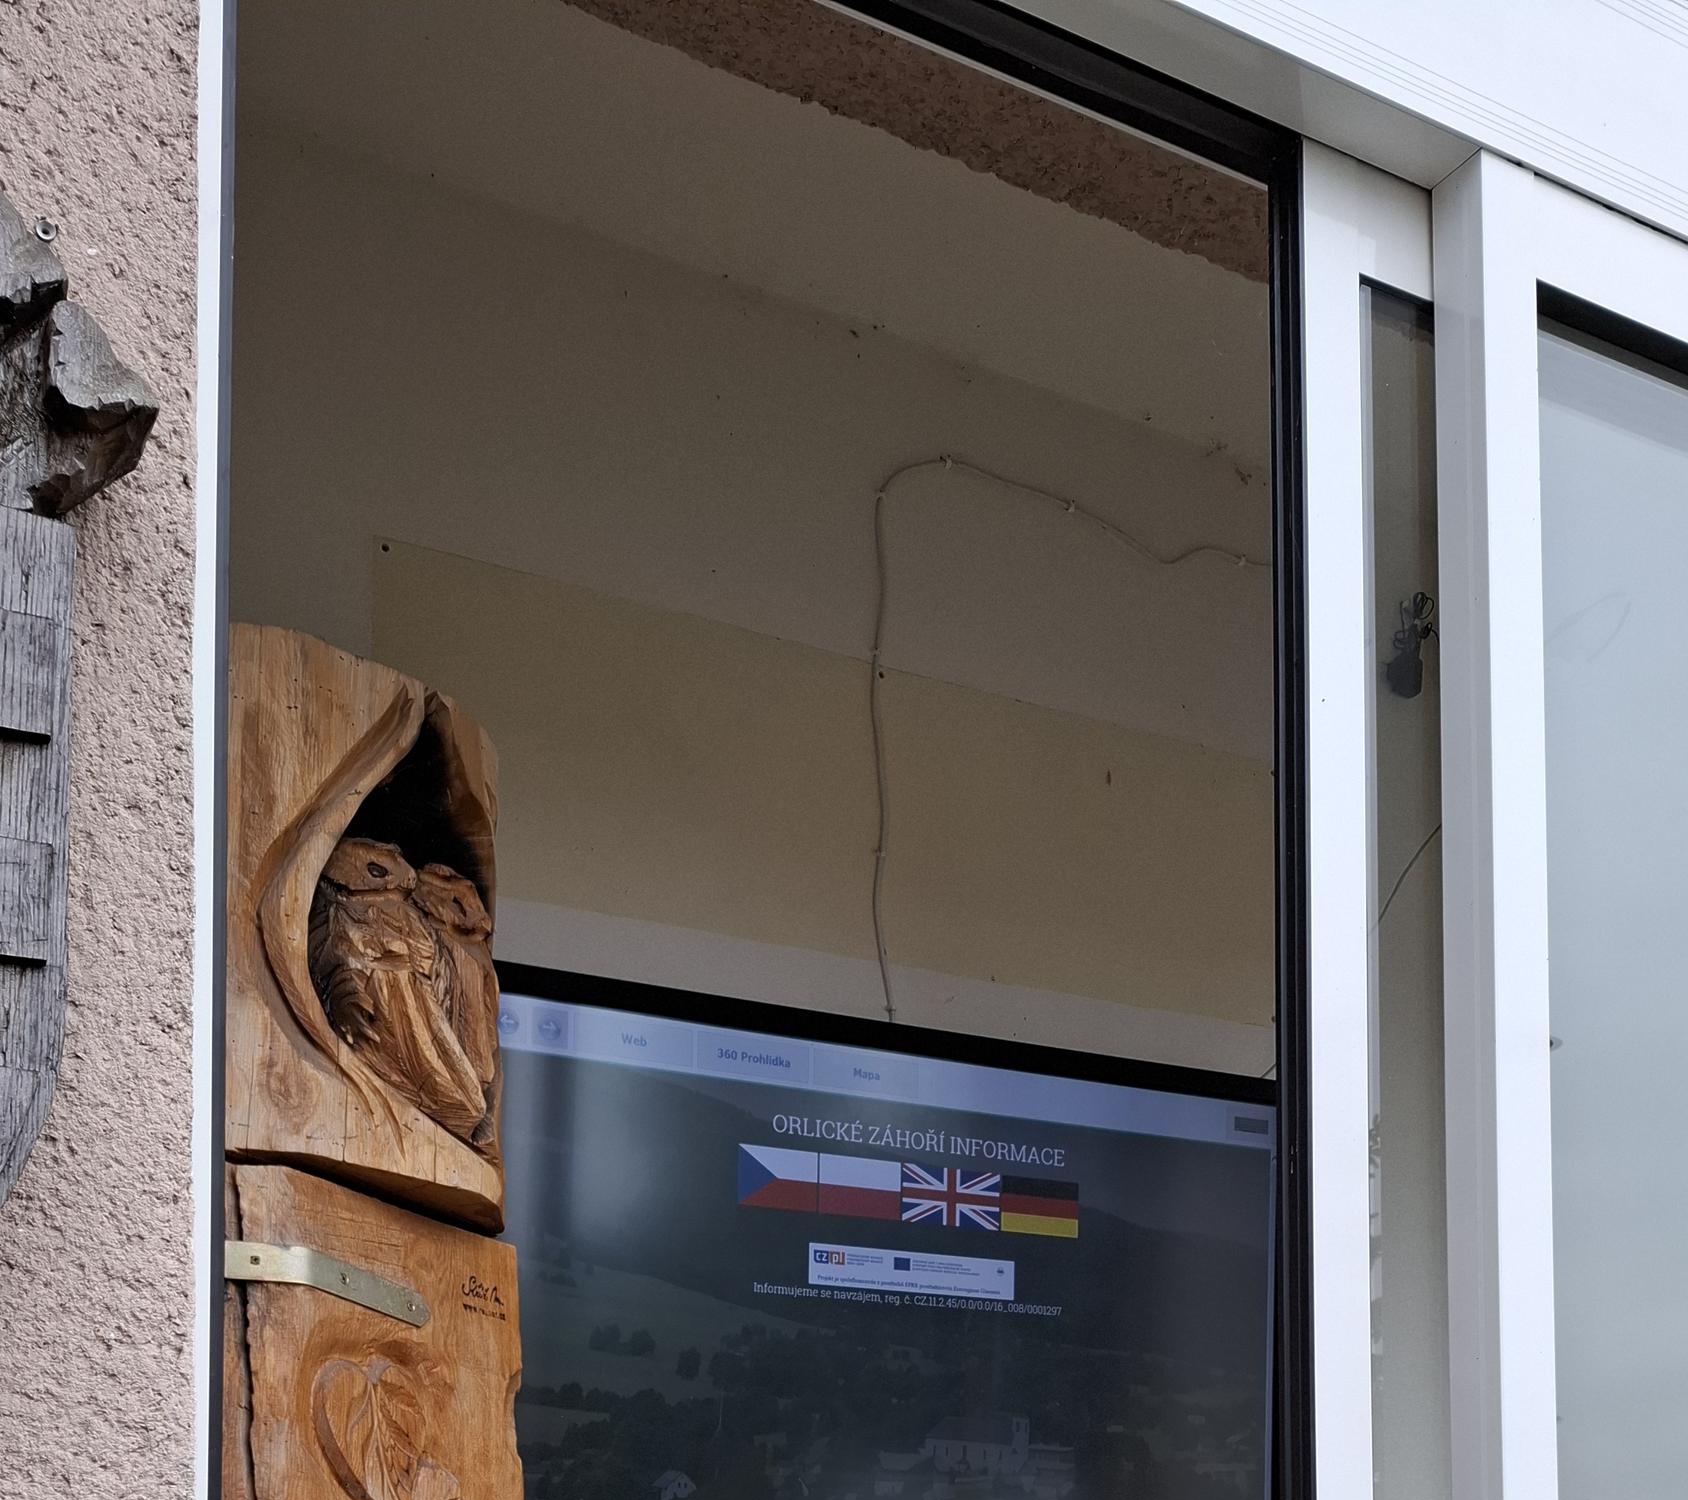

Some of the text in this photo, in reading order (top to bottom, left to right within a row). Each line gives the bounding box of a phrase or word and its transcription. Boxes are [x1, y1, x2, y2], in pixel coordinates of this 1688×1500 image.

[621, 1032, 648, 1048] Web
[717, 1047, 738, 1061] 360
[853, 1066, 881, 1082] Mapa
[772, 1113, 1066, 1167] ORLICKÉ ZÁHOŘÍ INFORMACE
[753, 1282, 818, 1298] Informujeme
[820, 1288, 832, 1298] se
[884, 1294, 902, 1306] reg.
